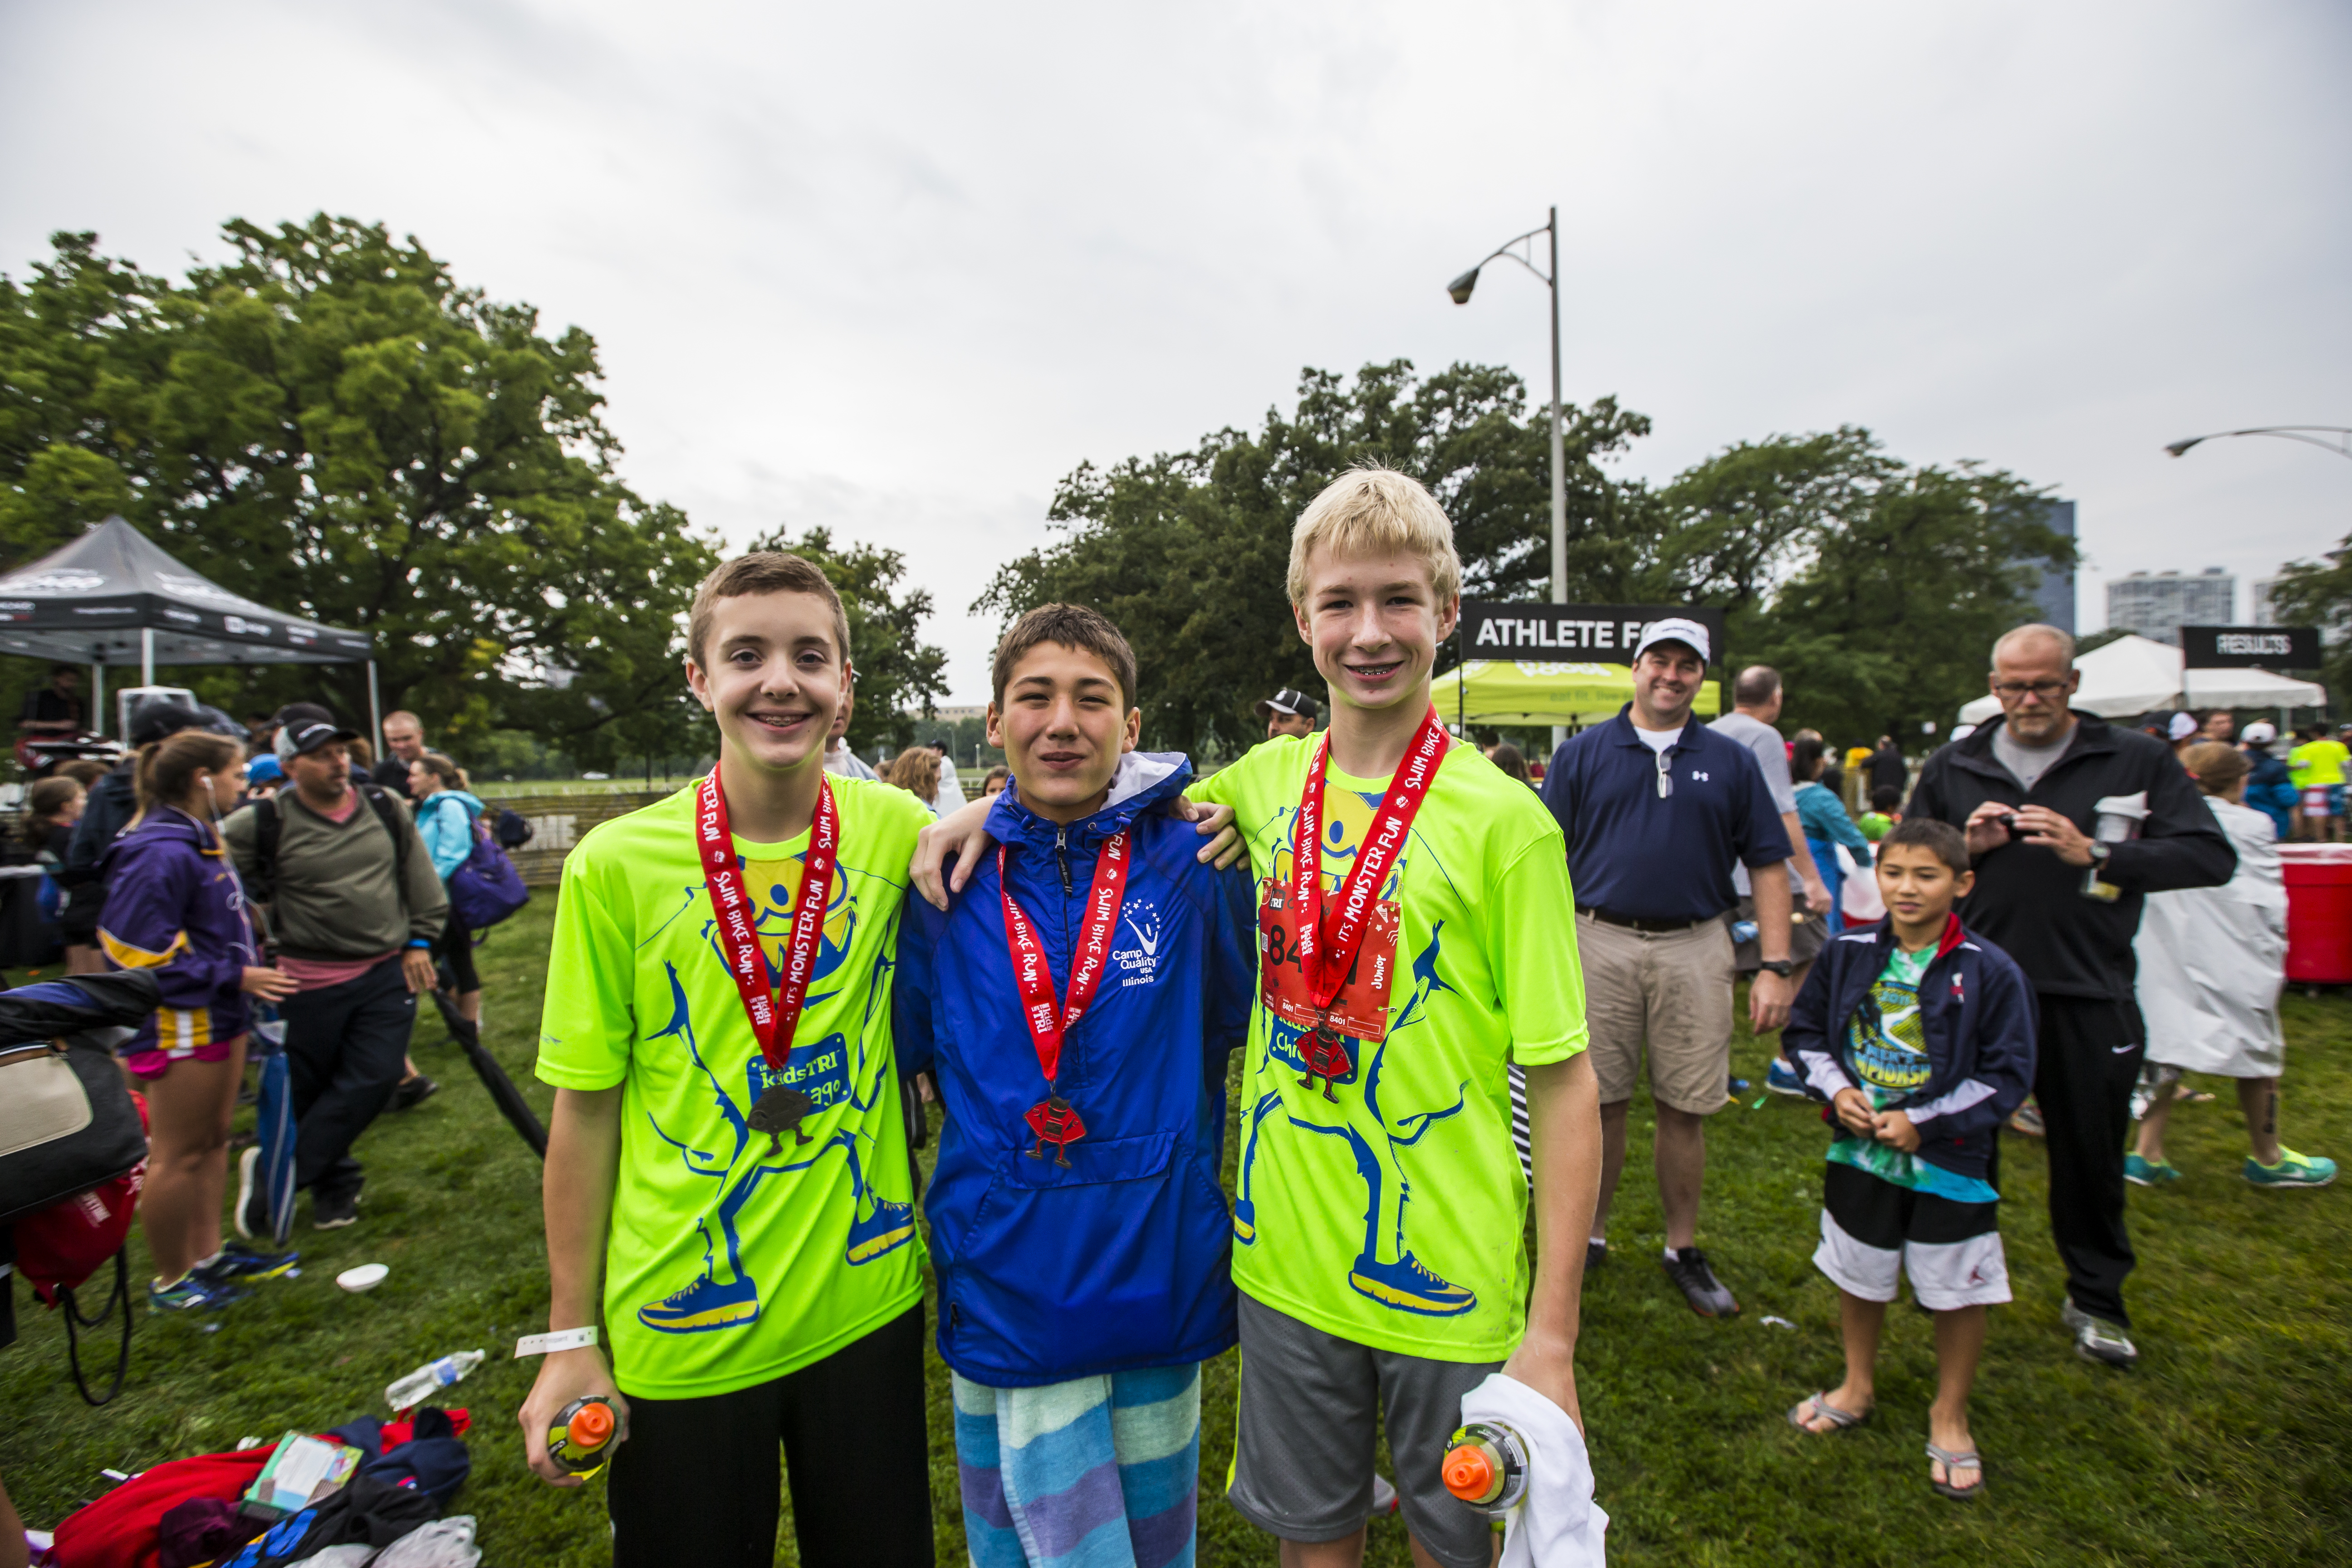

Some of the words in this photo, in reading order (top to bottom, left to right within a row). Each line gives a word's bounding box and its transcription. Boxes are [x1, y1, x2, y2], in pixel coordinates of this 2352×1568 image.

[1475, 618, 1614, 649] ATHLETE
[2216, 634, 2292, 655] RESULTS
[1310, 748, 1322, 775] FUN
[1405, 755, 1428, 790] SWIM
[1421, 727, 1440, 757] BIKE
[823, 785, 832, 813] BIKE
[702, 812, 721, 841] FUN
[818, 816, 832, 849] SWIM
[1303, 801, 1315, 836] SWIM
[1108, 834, 1123, 861] FUN
[1300, 837, 1313, 868] BIKE
[1344, 847, 1386, 923] MONSTER
[1378, 816, 1402, 849] FUN
[1298, 871, 1313, 901] RUN
[1096, 888, 1113, 921] SWIM
[713, 871, 740, 908] SWIM
[727, 909, 750, 942] BIKE
[739, 944, 754, 974] RUN
[789, 911, 815, 984] MONSTER
[806, 879, 824, 910] FUN
[1014, 922, 1034, 951] BIKE
[1088, 924, 1105, 954] BIKE
[1023, 954, 1038, 982] RUN
[1112, 950, 1142, 960] Camp
[1120, 956, 1156, 970] Quality
[1077, 956, 1098, 985] RUN
[1122, 975, 1154, 987] Illinois
[752, 1002, 765, 1025] TRI
[1033, 1009, 1048, 1034] TRI
[1043, 1008, 1054, 1031] kids
[1283, 1002, 1294, 1013] 8401
[1330, 1015, 1345, 1025] 8401
